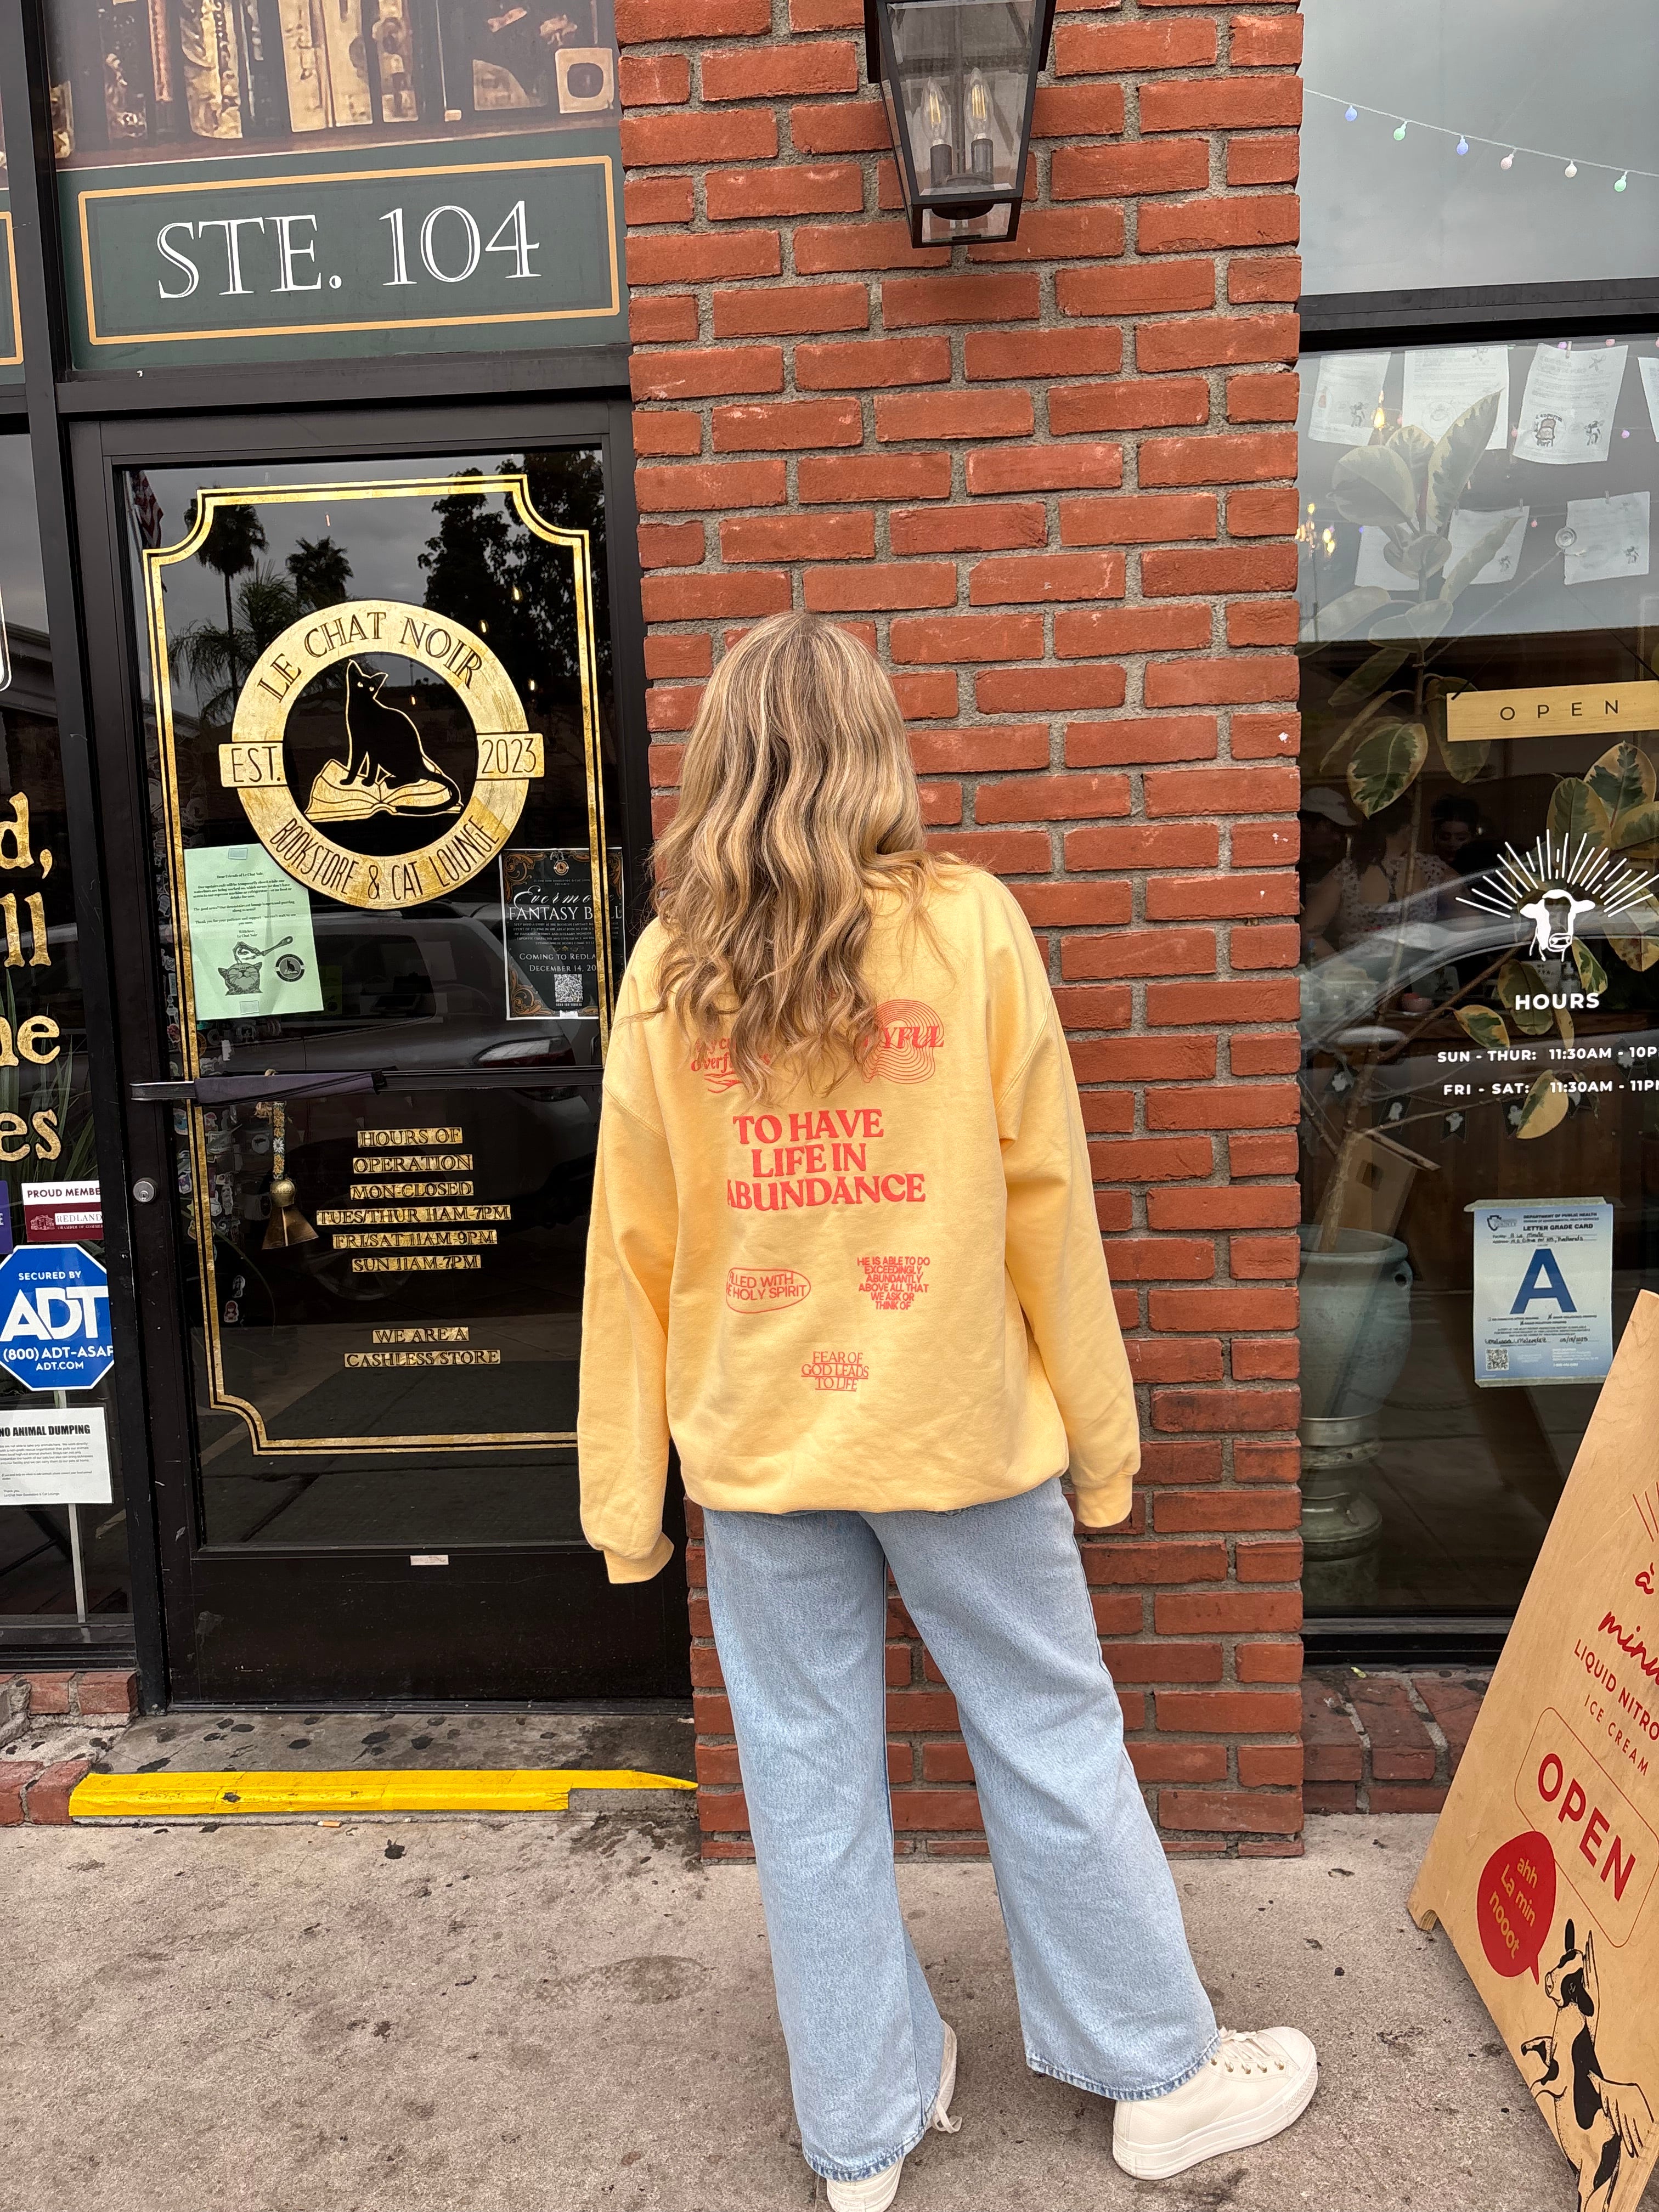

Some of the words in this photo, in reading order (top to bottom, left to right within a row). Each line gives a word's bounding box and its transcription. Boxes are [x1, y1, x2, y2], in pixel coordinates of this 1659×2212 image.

[157, 215, 342, 300] STE.
[381, 200, 542, 287] 104
[257, 653, 302, 702] LE
[304, 612, 387, 658] CHAT
[399, 617, 483, 689] NOIR
[1500, 699, 1620, 721] OPEN
[232, 746, 281, 782] EST.
[481, 738, 537, 774] 2023
[270, 817, 359, 895] BOOKSTORE
[368, 865, 380, 900] &
[392, 864, 426, 900] CAT
[432, 815, 500, 888] LOUNGE
[514, 885, 615, 911] Evermoe
[509, 907, 579, 920] FANTASY
[584, 906, 622, 919] BL
[1515, 993, 1600, 1011] HOURS
[1437, 1051, 1470, 1063] SUN
[1487, 1049, 1537, 1062] THUR:
[1549, 1047, 1612, 1061] 11:30AM
[1629, 1046, 1659, 1058] 10P
[1443, 1084, 1471, 1096] FRI
[1492, 1082, 1530, 1095] SAT:
[1550, 1081, 1613, 1093] 11:30AM
[733, 1115, 782, 1144] TO
[789, 1109, 884, 1142] HAVE
[359, 1128, 429, 1148] HOURS
[435, 1128, 461, 1143] OF
[354, 1155, 471, 1172] OPERATION
[751, 1144, 827, 1178] LIFE
[831, 1143, 867, 1171] IN
[27, 1189, 63, 1198] PROUD
[65, 1188, 101, 1197] MEMBE
[727, 1173, 926, 1211] ABUNDANCE
[57, 1213, 103, 1223] REDLAND
[317, 1209, 422, 1224] TUES/THUR
[353, 1259, 390, 1272] SUN
[857, 1257, 870, 1266] HE
[872, 1256, 881, 1265] IS
[882, 1256, 904, 1265] ABLE
[905, 1256, 916, 1265] TO
[917, 1256, 930, 1266] DO
[18, 1271, 66, 1281] SECURED
[69, 1271, 82, 1279] BY
[864, 1265, 924, 1274] EXCEEDINGLY,
[760, 1272, 794, 1288] WITH
[866, 1273, 923, 1283] ABUNDANTLY
[1509, 1248, 1578, 1315] A
[733, 1286, 765, 1300] HOLY
[769, 1284, 807, 1299] SPIRIT
[858, 1283, 889, 1292] ABOVE
[890, 1283, 905, 1292] ALL
[906, 1283, 929, 1293] THAT
[871, 1292, 884, 1301] WE
[885, 1292, 901, 1301] ASK
[902, 1292, 915, 1301] OR
[0, 1285, 109, 1342] ADT
[875, 1301, 899, 1310] THINK
[899, 1301, 911, 1311] OF
[374, 1330, 405, 1344] WE
[410, 1329, 449, 1342] ARE
[455, 1328, 468, 1341] A
[3, 1347, 39, 1362] (800)
[346, 1352, 435, 1367] CASHLESS
[438, 1350, 499, 1365] STORE
[812, 1351, 845, 1363] FEAR
[848, 1352, 864, 1364] OF
[36, 1361, 84, 1371] ADT.COM
[801, 1363, 832, 1375] GOD
[835, 1363, 870, 1378] LEADS
[815, 1377, 834, 1389] TO
[837, 1377, 859, 1390] LIFE
[13, 1425, 47, 1437] ANIMAL
[48, 1424, 91, 1436] DUMPING
[1574, 1638, 1617, 1692] LIQUID
[1584, 1694, 1604, 1723] ICE
[1607, 1722, 1649, 1776] CREAM
[1538, 1753, 1636, 1902] OPEN
[1517, 1857, 1538, 1888] ahh
[1501, 1863, 1515, 1898] La
[1515, 1889, 1536, 1927] min
[1489, 1890, 1521, 1959] nooot
